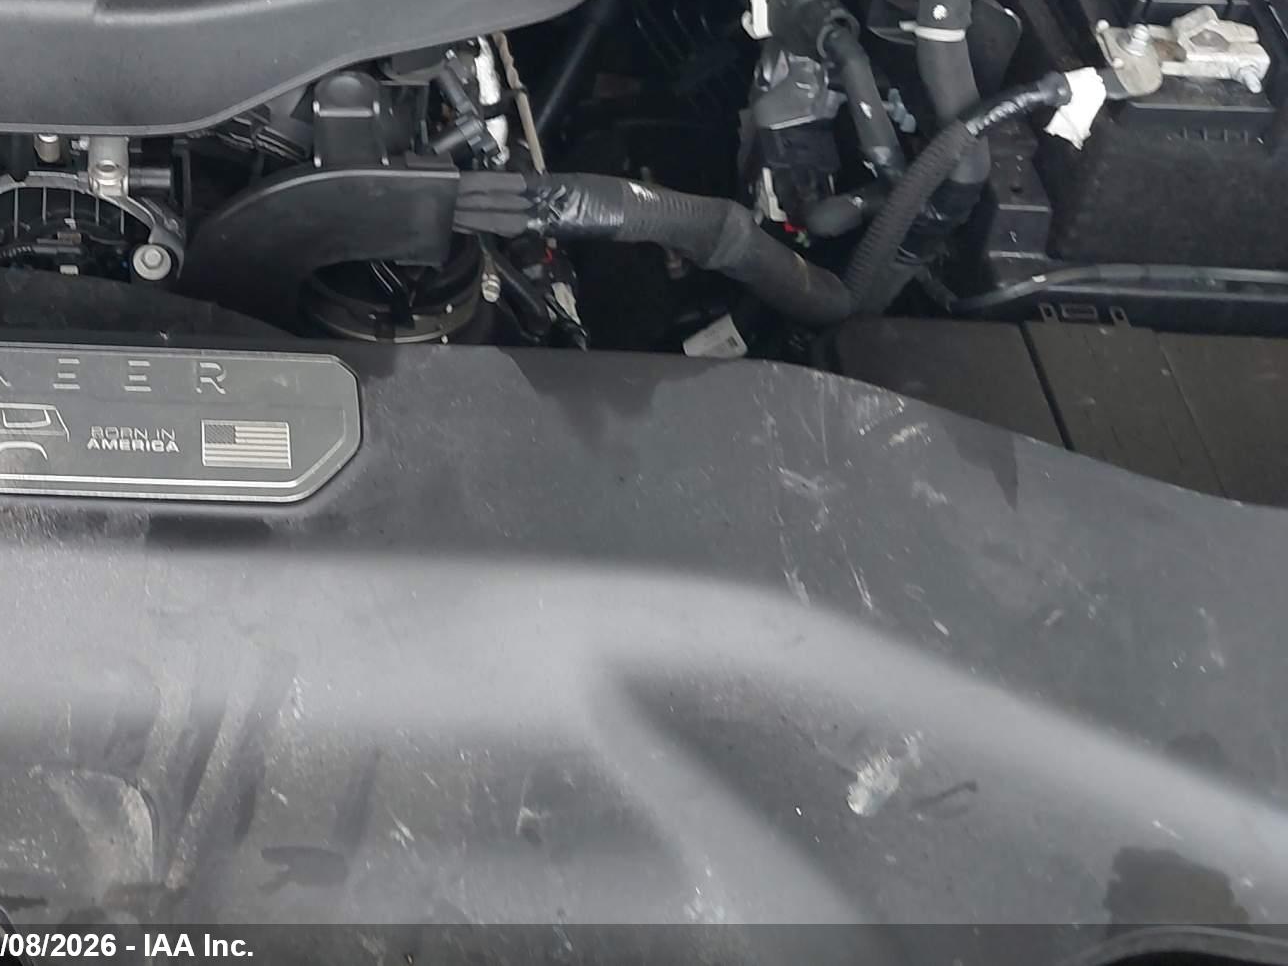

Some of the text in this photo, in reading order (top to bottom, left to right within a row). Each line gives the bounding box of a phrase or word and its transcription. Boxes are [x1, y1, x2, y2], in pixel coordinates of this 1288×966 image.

[90, 425, 177, 441] BORN IN
[87, 438, 180, 453] AMERICA
